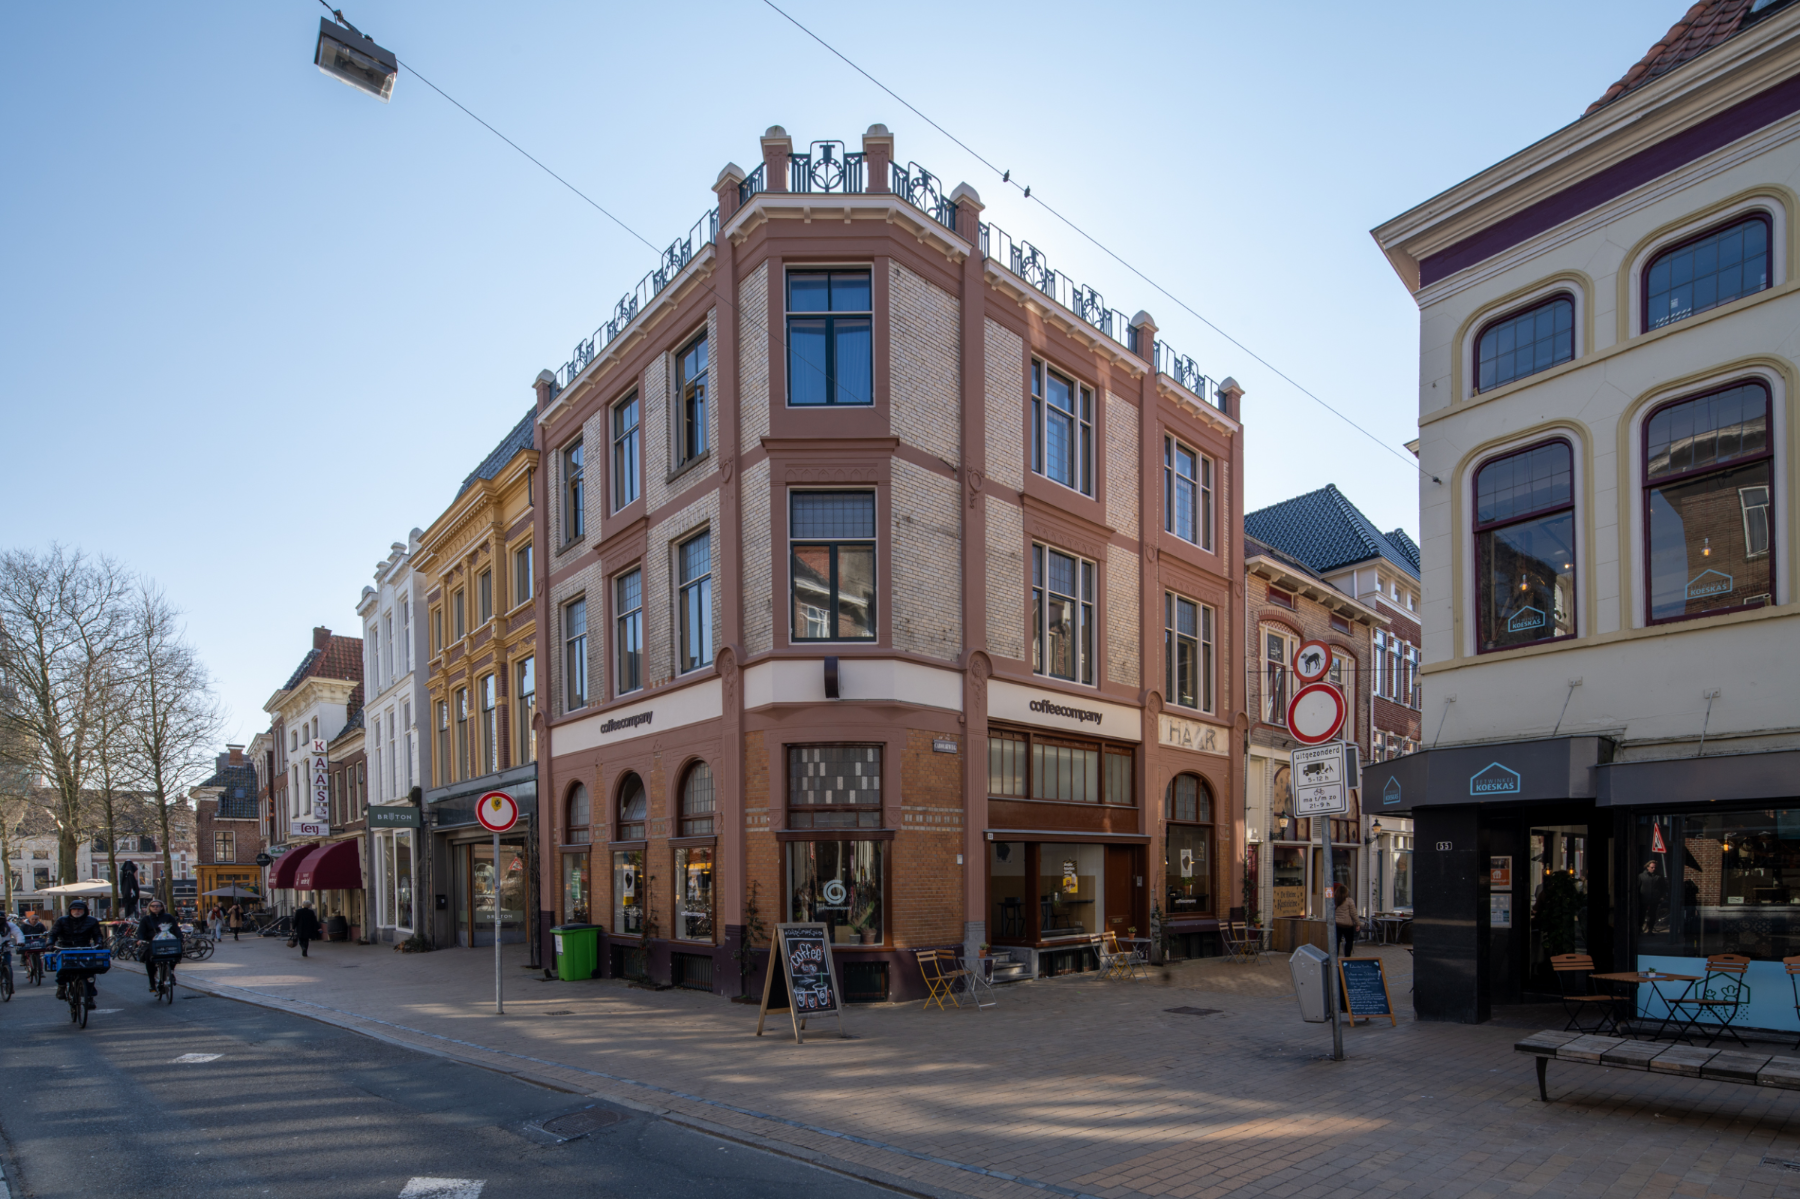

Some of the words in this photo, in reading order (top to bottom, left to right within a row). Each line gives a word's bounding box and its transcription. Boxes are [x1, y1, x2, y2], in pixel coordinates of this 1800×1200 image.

[1690, 584, 1727, 596] KOESKAS
[1512, 619, 1541, 629] KOESKAS
[1029, 699, 1103, 725] coffeecompany
[600, 710, 653, 734] coffeecompany
[1296, 746, 1340, 760] uitgezonderd
[313, 740, 327, 802] KAAS
[1476, 782, 1514, 791] KOESKAS
[790, 943, 822, 967] coffee
